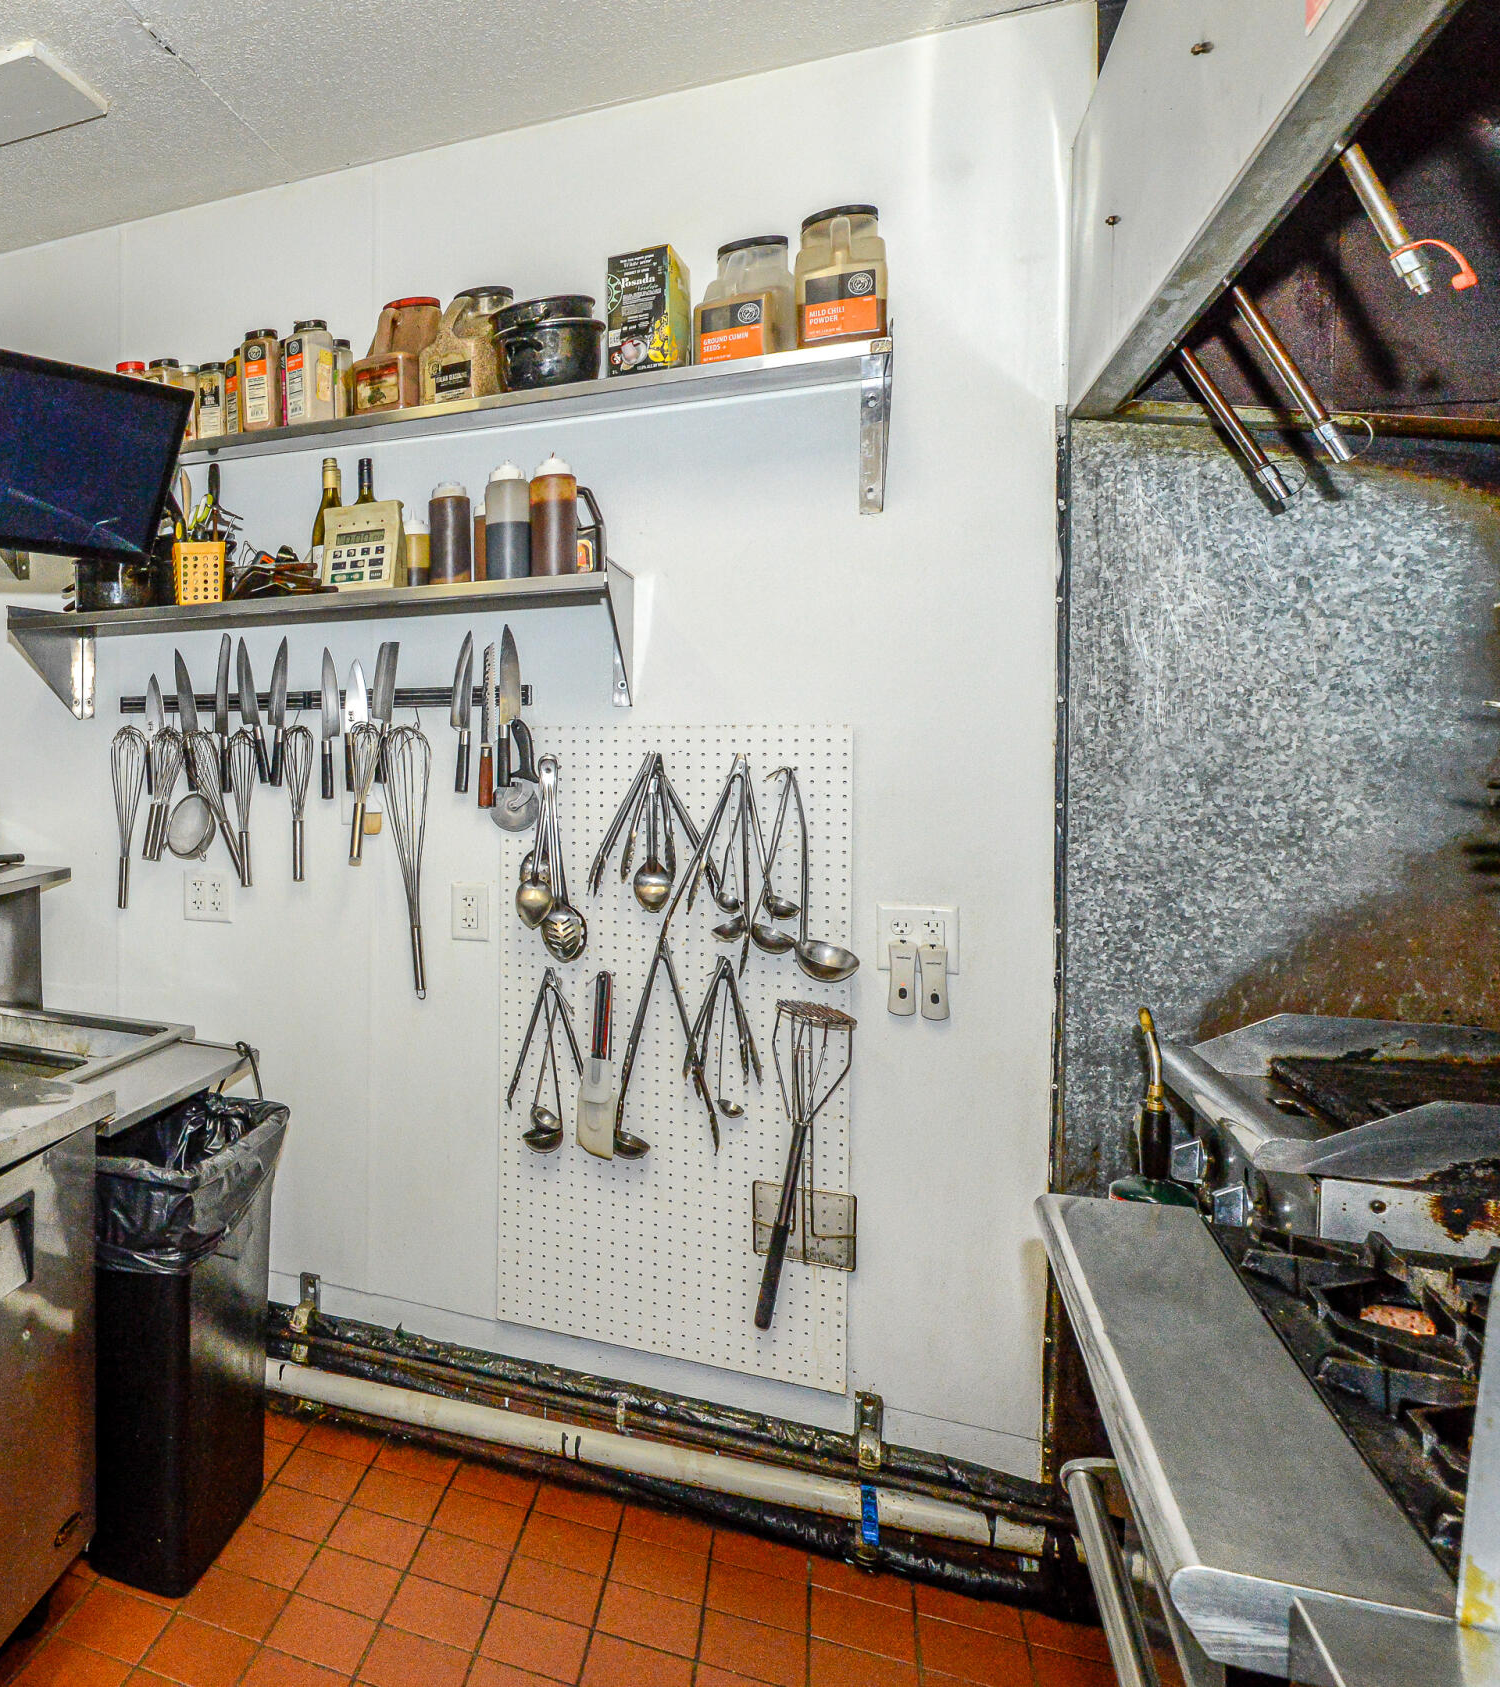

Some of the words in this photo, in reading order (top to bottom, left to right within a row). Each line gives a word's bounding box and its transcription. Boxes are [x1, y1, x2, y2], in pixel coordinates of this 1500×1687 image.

[620, 273, 655, 289] Posada
[809, 308, 827, 318] MILD
[827, 306, 845, 315] CHILI
[809, 315, 839, 326] POWDER
[703, 335, 728, 346] GROUND
[728, 331, 749, 342] CUMIN
[703, 343, 721, 352] SEEDS
